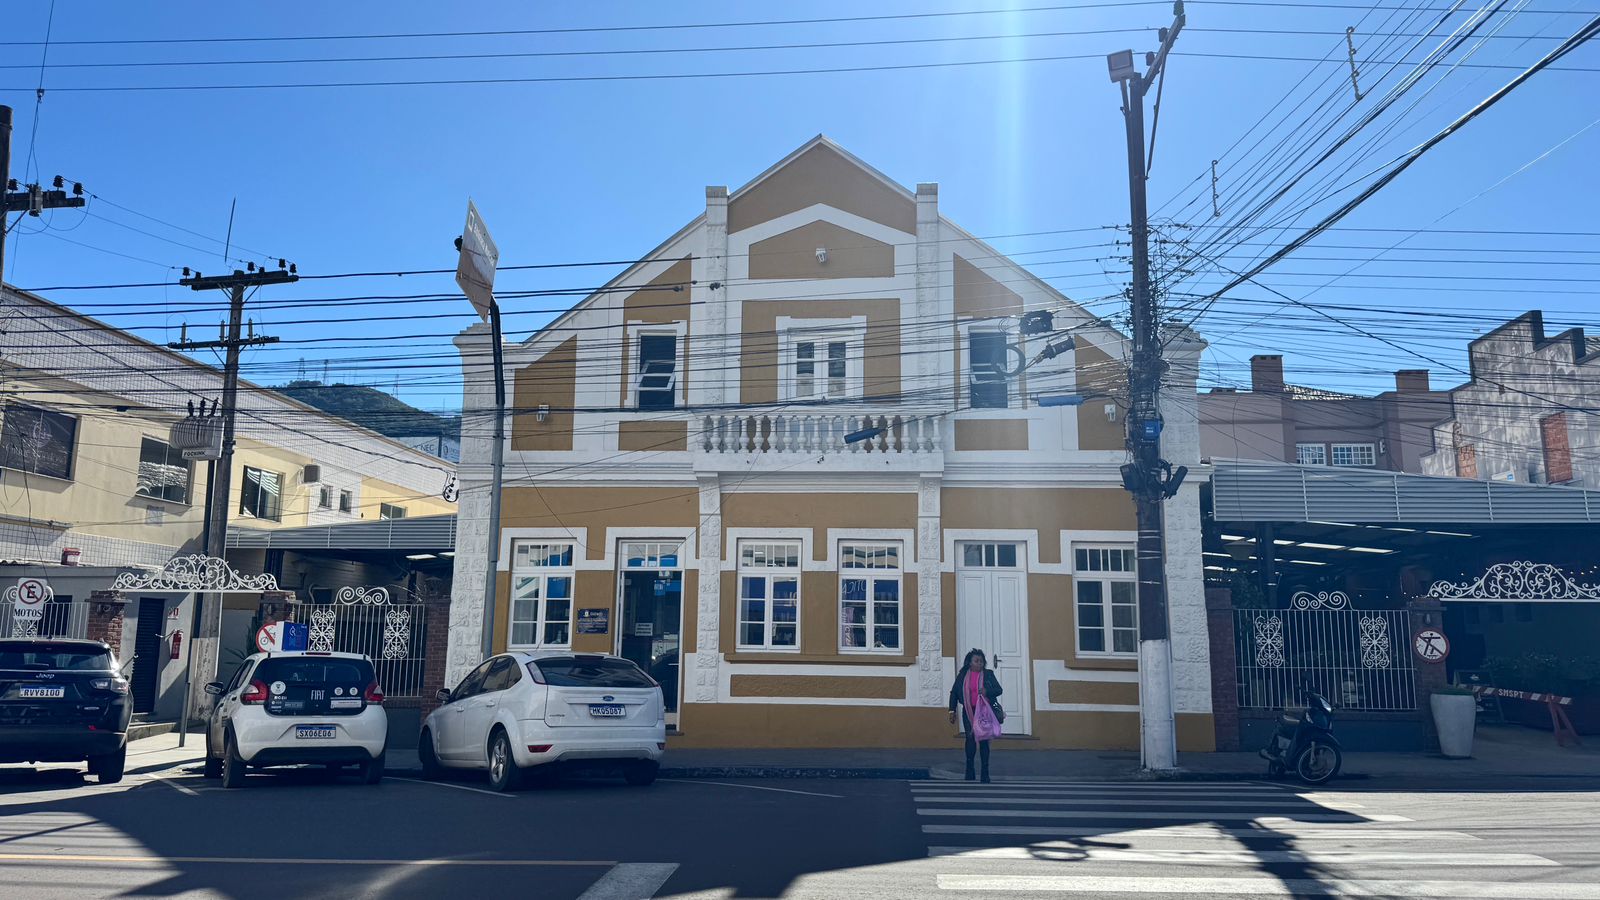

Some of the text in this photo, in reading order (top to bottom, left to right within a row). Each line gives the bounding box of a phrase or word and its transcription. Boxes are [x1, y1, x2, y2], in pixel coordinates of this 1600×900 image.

[13, 608, 43, 618] MOTOS
[310, 689, 325, 701] FIAT
[1498, 688, 1524, 699] SMSPT
